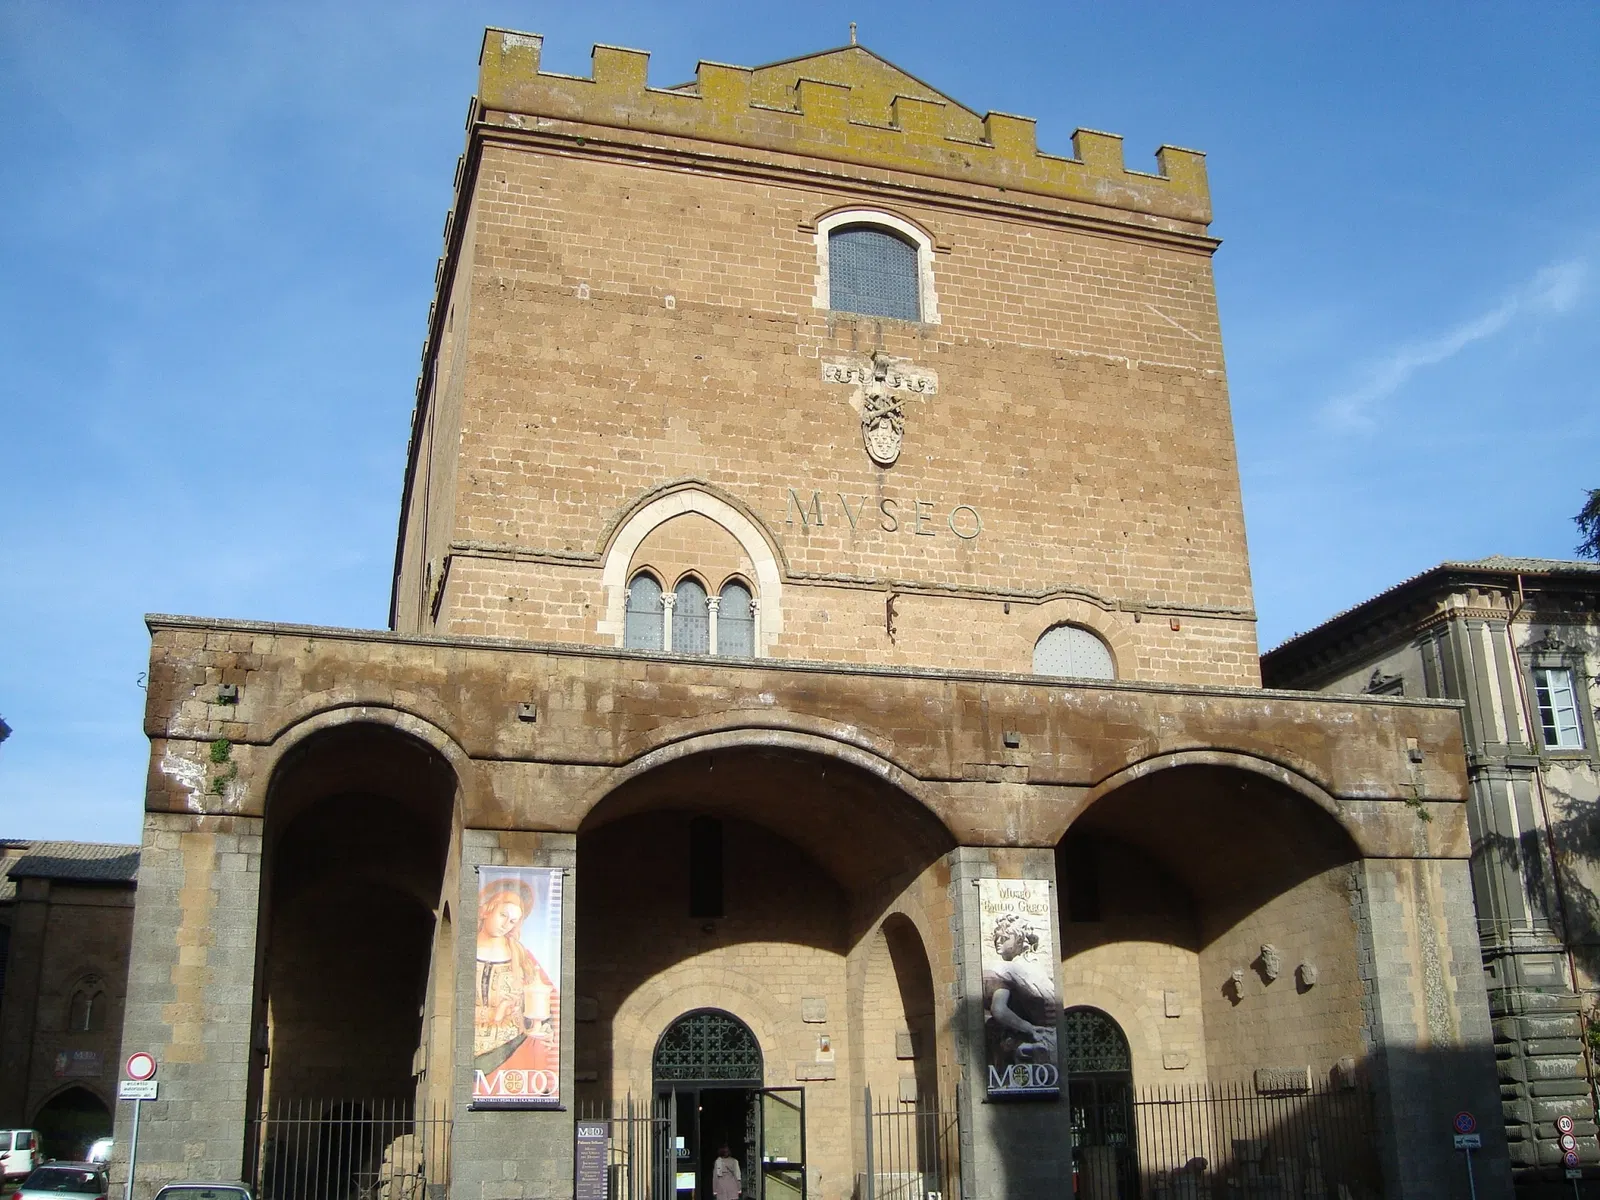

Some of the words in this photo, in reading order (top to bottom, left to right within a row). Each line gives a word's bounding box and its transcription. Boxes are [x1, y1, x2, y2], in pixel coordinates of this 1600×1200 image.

[472, 1069, 557, 1095] MODO
[987, 1063, 1059, 1088] MODO
[1561, 1120, 1570, 1128] 30
